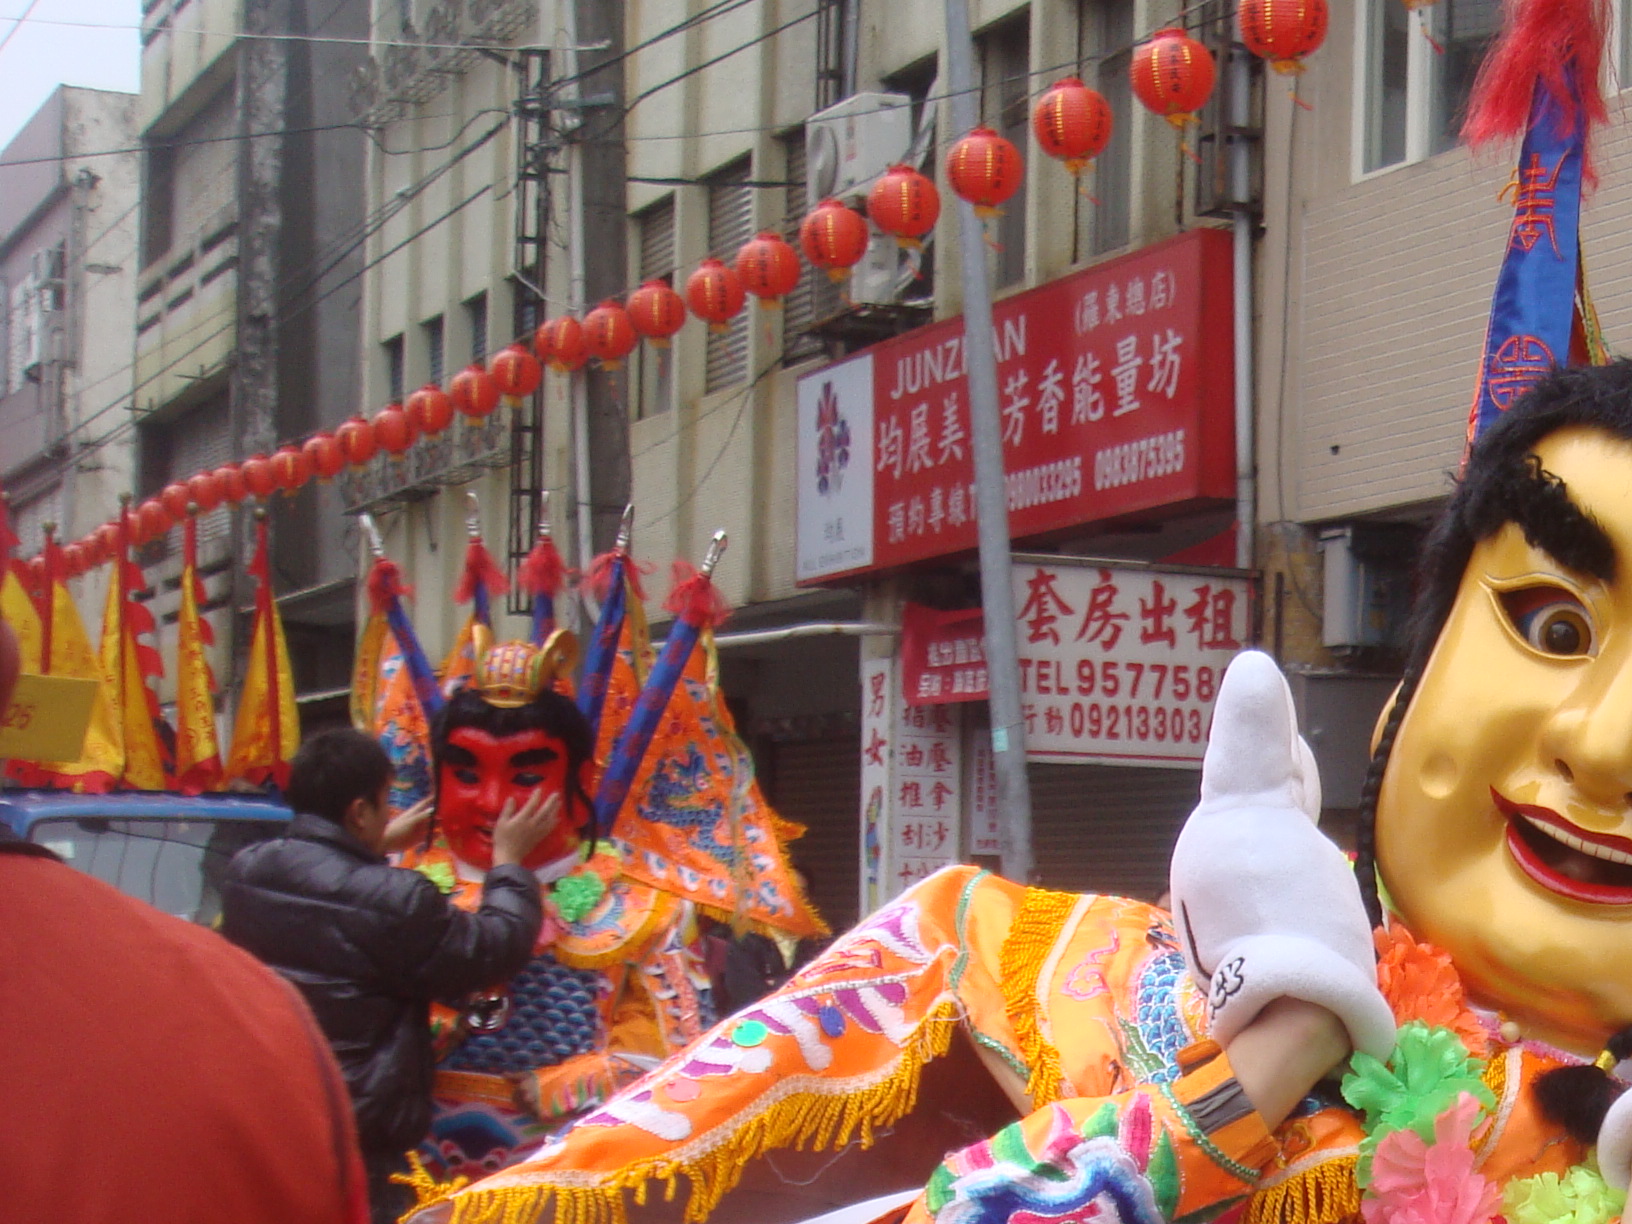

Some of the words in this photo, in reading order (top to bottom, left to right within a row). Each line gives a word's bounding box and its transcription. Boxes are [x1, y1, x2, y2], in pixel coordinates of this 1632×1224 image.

[890, 314, 1027, 400] JUNZN
[876, 328, 1184, 481] 均展美芳香能量坊
[1017, 567, 1242, 652] 套房出租
[866, 672, 887, 767] 男女
[1018, 658, 1070, 696] TEL
[1076, 658, 1228, 702] 957758
[1070, 702, 1213, 743] 09213303
[899, 781, 953, 812] 推拿
